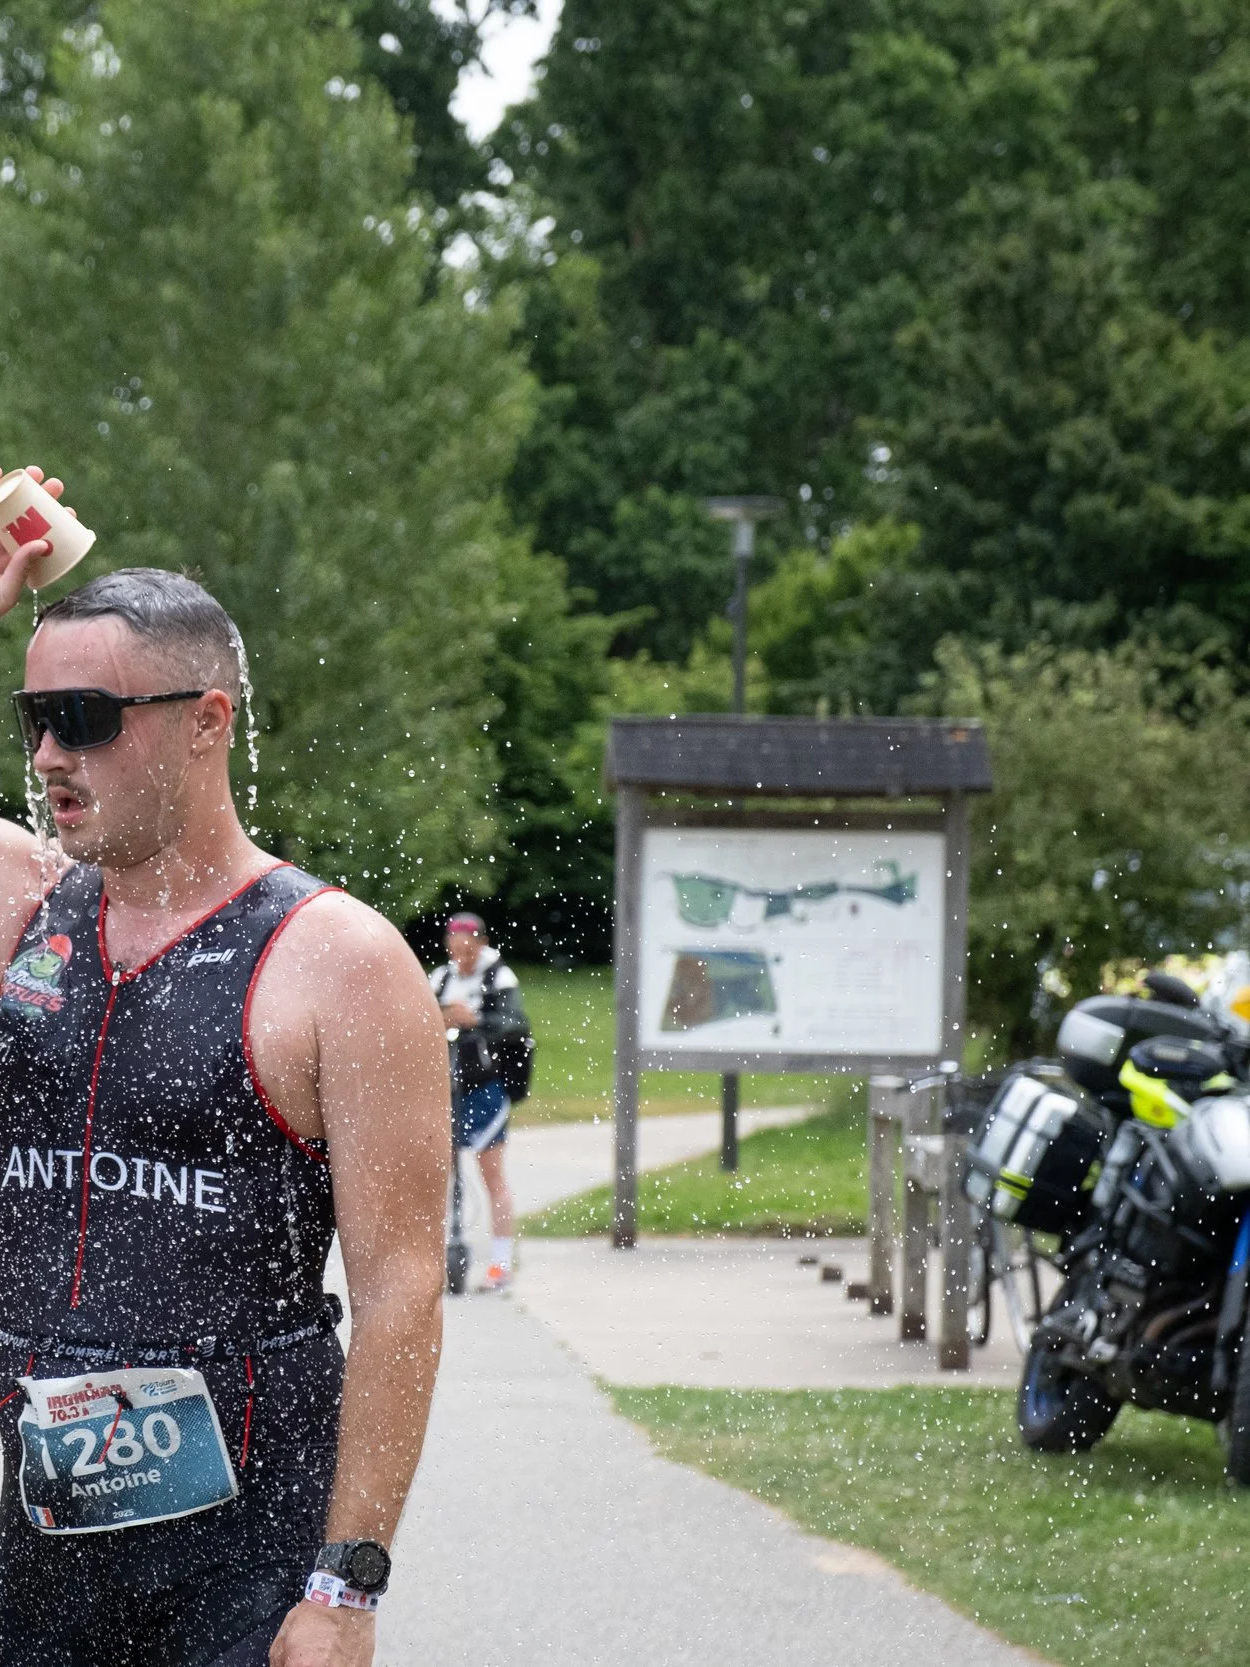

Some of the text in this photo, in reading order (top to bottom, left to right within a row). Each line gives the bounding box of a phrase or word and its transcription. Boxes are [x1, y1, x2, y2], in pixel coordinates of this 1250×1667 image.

[2, 1146, 227, 1213] ANTOINE
[49, 1406, 80, 1423] 70.3
[72, 1467, 161, 1498] Antoine
[112, 1508, 134, 1520] 2025
